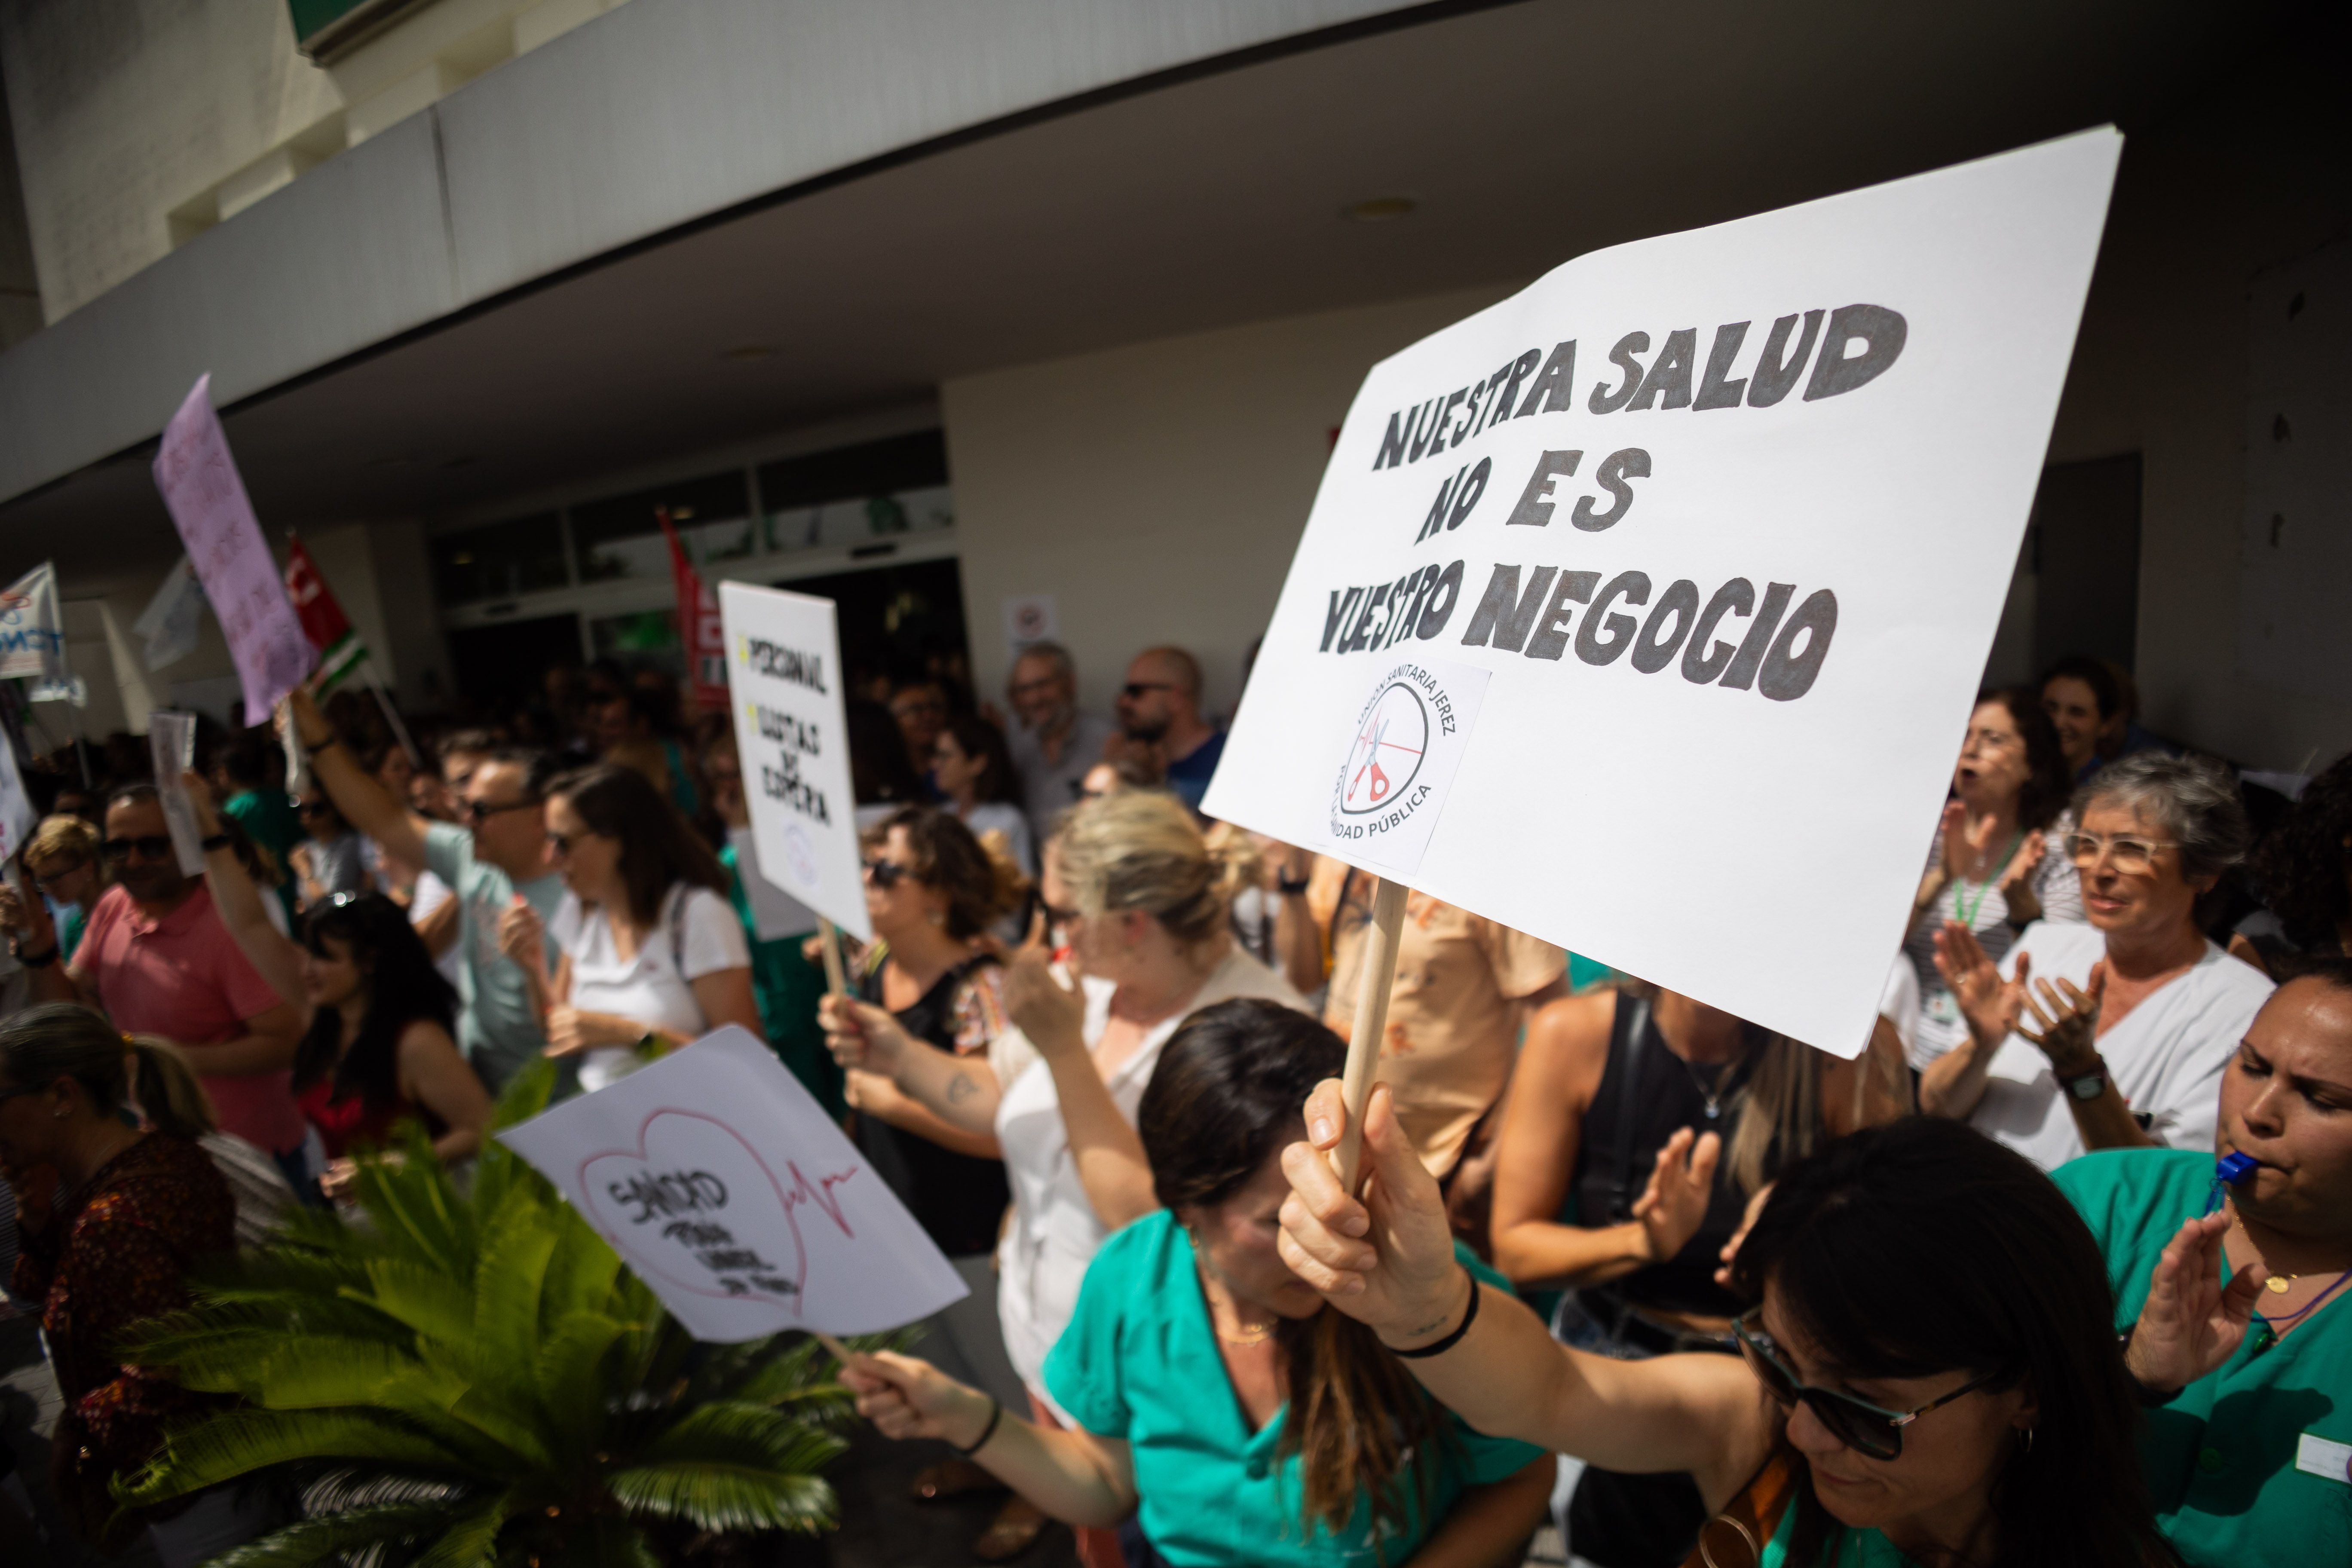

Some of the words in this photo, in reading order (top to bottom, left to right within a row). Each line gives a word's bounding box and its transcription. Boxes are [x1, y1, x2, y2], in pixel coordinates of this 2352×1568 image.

[1372, 338, 1577, 471] NUESTRA
[1588, 303, 1908, 416] SALUD
[1414, 456, 1492, 545] NO
[1505, 447, 1652, 533] ES
[1319, 559, 1465, 655] VUESTRO
[1460, 562, 1838, 702] NEGOCIO
[1357, 678, 1386, 726] UNIÓN
[1386, 663, 1437, 694] SANITARIA
[1428, 689, 1456, 737] JEREZ
[1369, 784, 1432, 837] PÚBLICA
